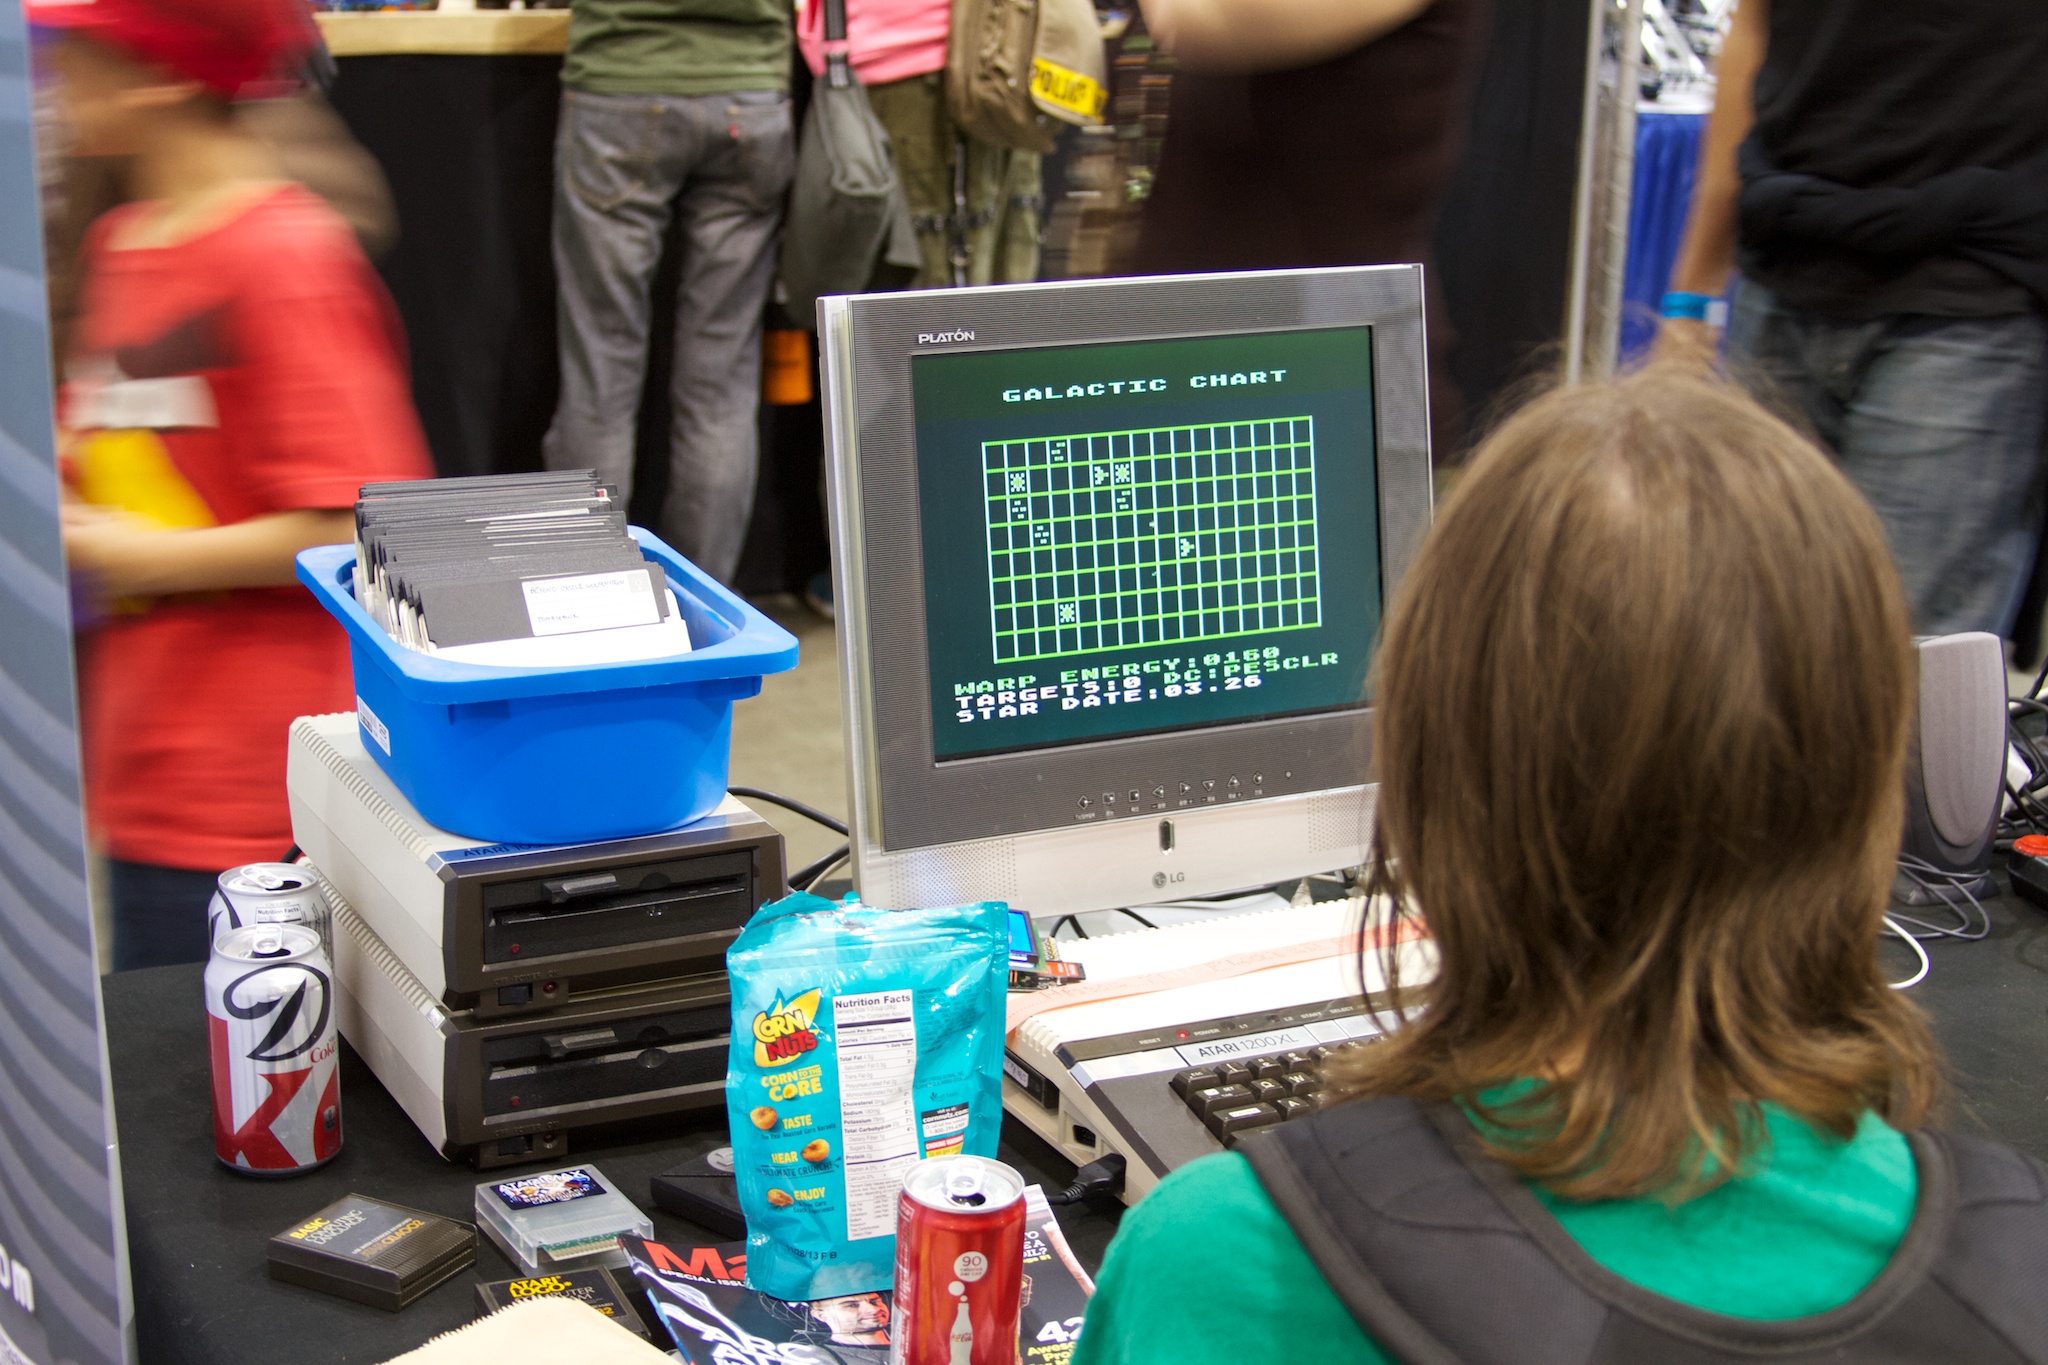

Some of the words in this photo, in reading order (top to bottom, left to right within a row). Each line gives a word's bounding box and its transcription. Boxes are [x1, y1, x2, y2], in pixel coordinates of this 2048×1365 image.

[918, 328, 975, 344] PLATÓN
[1002, 377, 1168, 403] GALACTIC
[1190, 369, 1288, 389] CHART
[954, 675, 1036, 696] WARP
[955, 676, 1142, 709] TARGETS:0
[956, 702, 1038, 723] STAR
[1061, 674, 1262, 711] DATE:03.26
[464, 844, 509, 857] ATARI
[835, 997, 880, 1009] Nutrition
[883, 994, 911, 1004] Facts
[752, 1009, 807, 1043] CORN
[1194, 1028, 1221, 1037] POWER
[1300, 1011, 1322, 1019] START
[765, 1030, 819, 1062] NUTS
[1198, 1042, 1241, 1058] ATARI
[761, 1070, 798, 1088] CORN
[769, 1077, 823, 1102] CORE
[782, 1114, 812, 1130] TASTE
[771, 1151, 798, 1164] HEAR
[798, 1161, 833, 1175] CRUNCH!
[793, 1186, 825, 1201] ENJOY
[289, 1217, 331, 1240] BASIC
[304, 1209, 363, 1242] COMPUTING
[313, 1216, 367, 1245] LANGUAGE
[1024, 1247, 1048, 1258] OIL?
[1033, 1239, 1046, 1248] A
[642, 1240, 746, 1281] Ma
[821, 1252, 828, 1260] F
[829, 1251, 837, 1259] B
[962, 1256, 982, 1267] 90
[510, 1275, 560, 1290] ATARI
[659, 1268, 716, 1284] SPECIAL
[718, 1279, 746, 1288] ISSU
